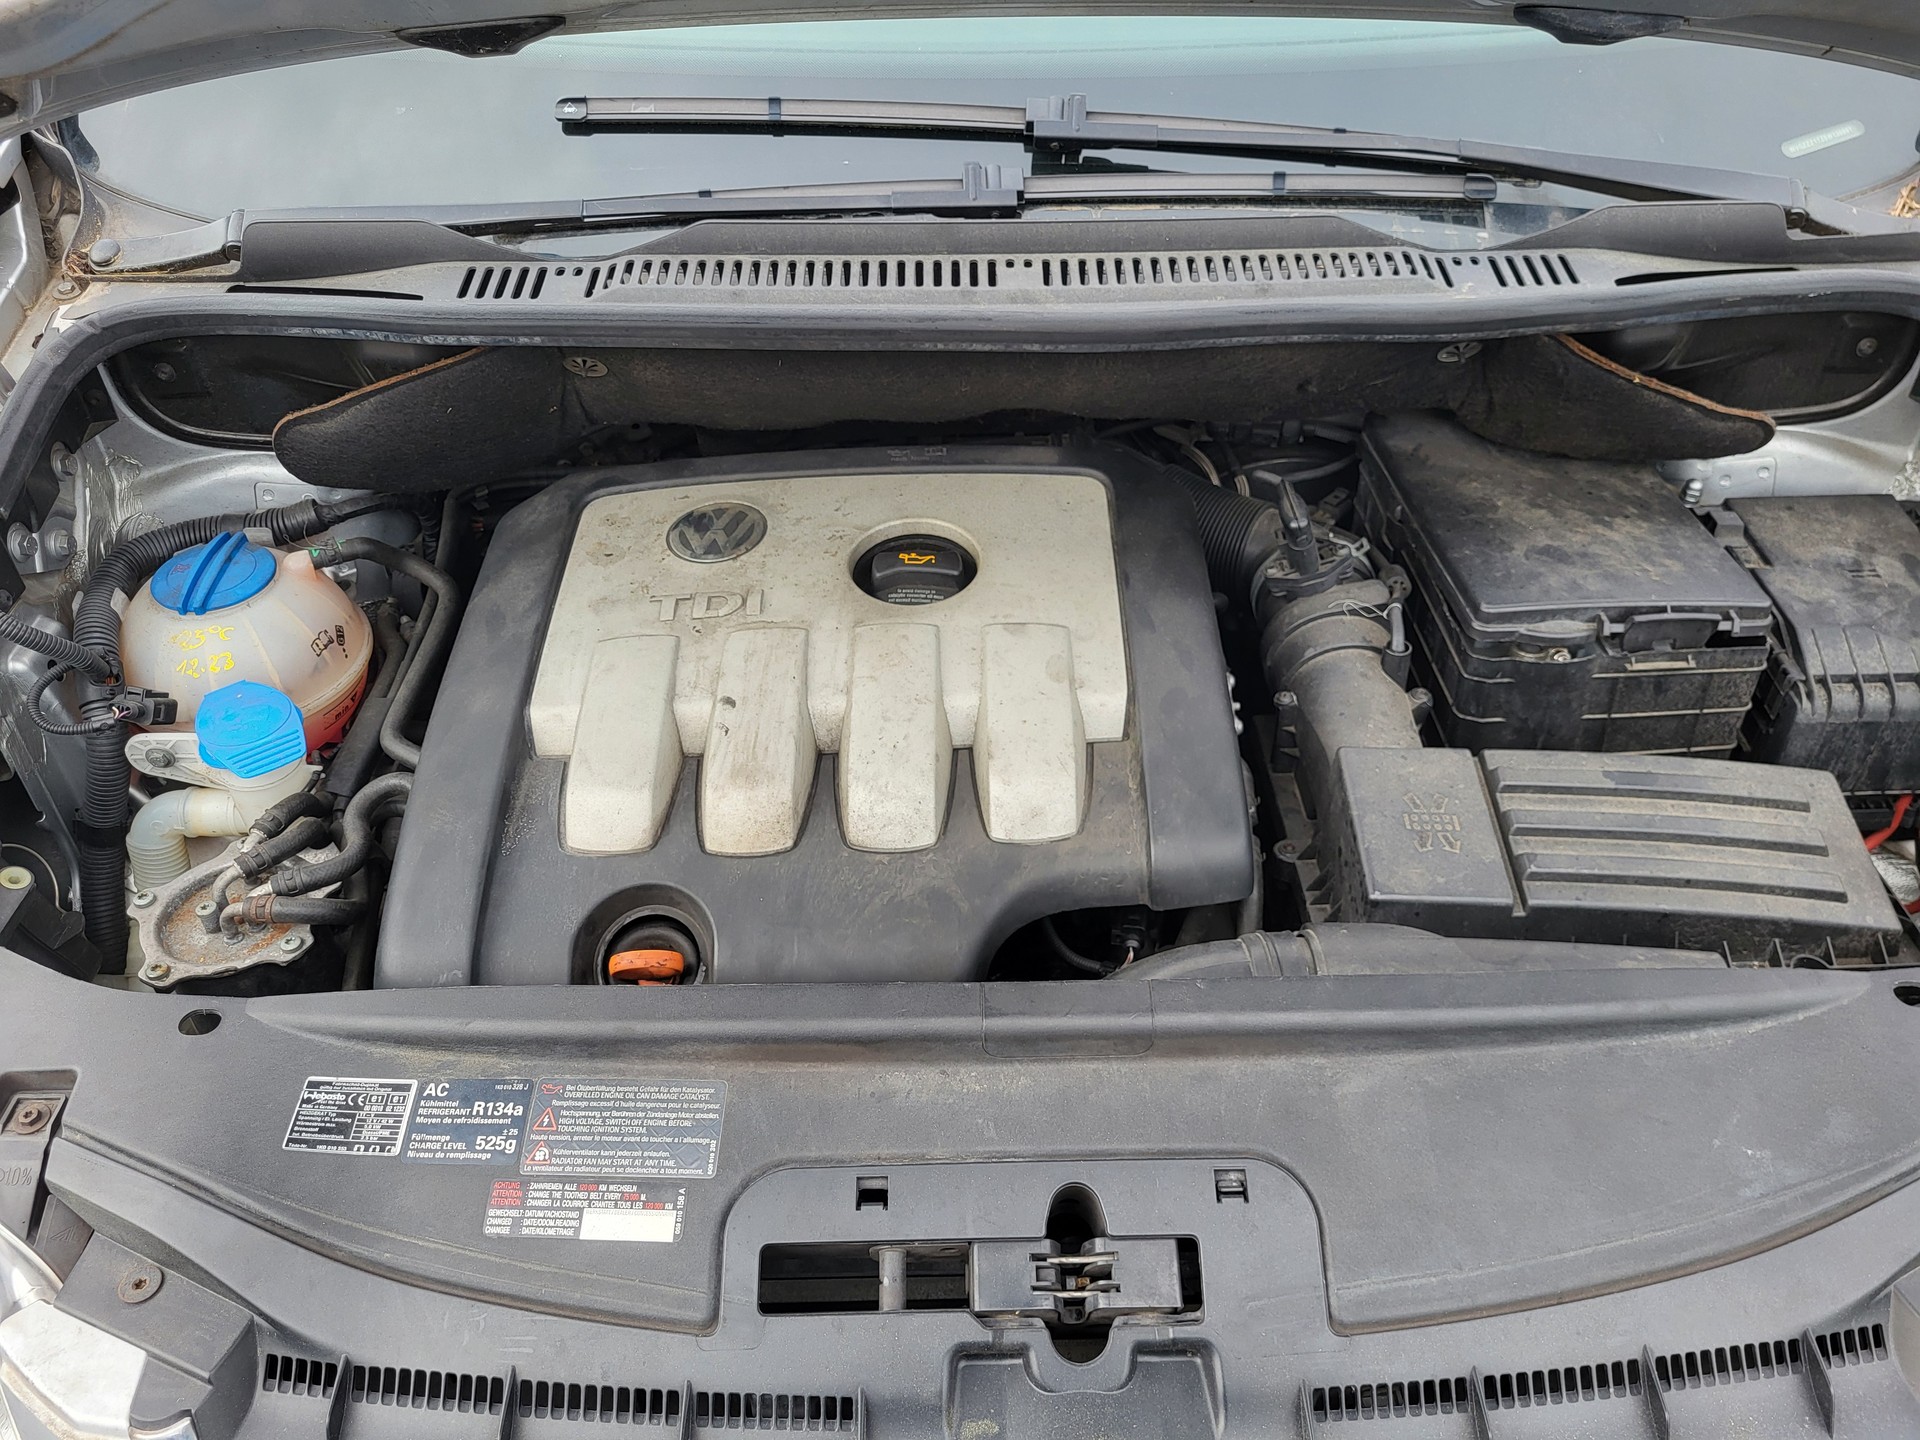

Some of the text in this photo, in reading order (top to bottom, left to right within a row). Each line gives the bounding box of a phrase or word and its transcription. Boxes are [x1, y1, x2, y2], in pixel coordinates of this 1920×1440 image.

[650, 589, 764, 621] TDI
[176, 652, 234, 678] 12.23
[334, 704, 350, 720] min
[304, 1091, 346, 1100] Webasto
[423, 1083, 450, 1097] AC
[472, 1102, 524, 1116] R134a
[412, 1134, 450, 1142] Füllmenge
[475, 1136, 517, 1154] 525g
[446, 1152, 492, 1160] remplissage
